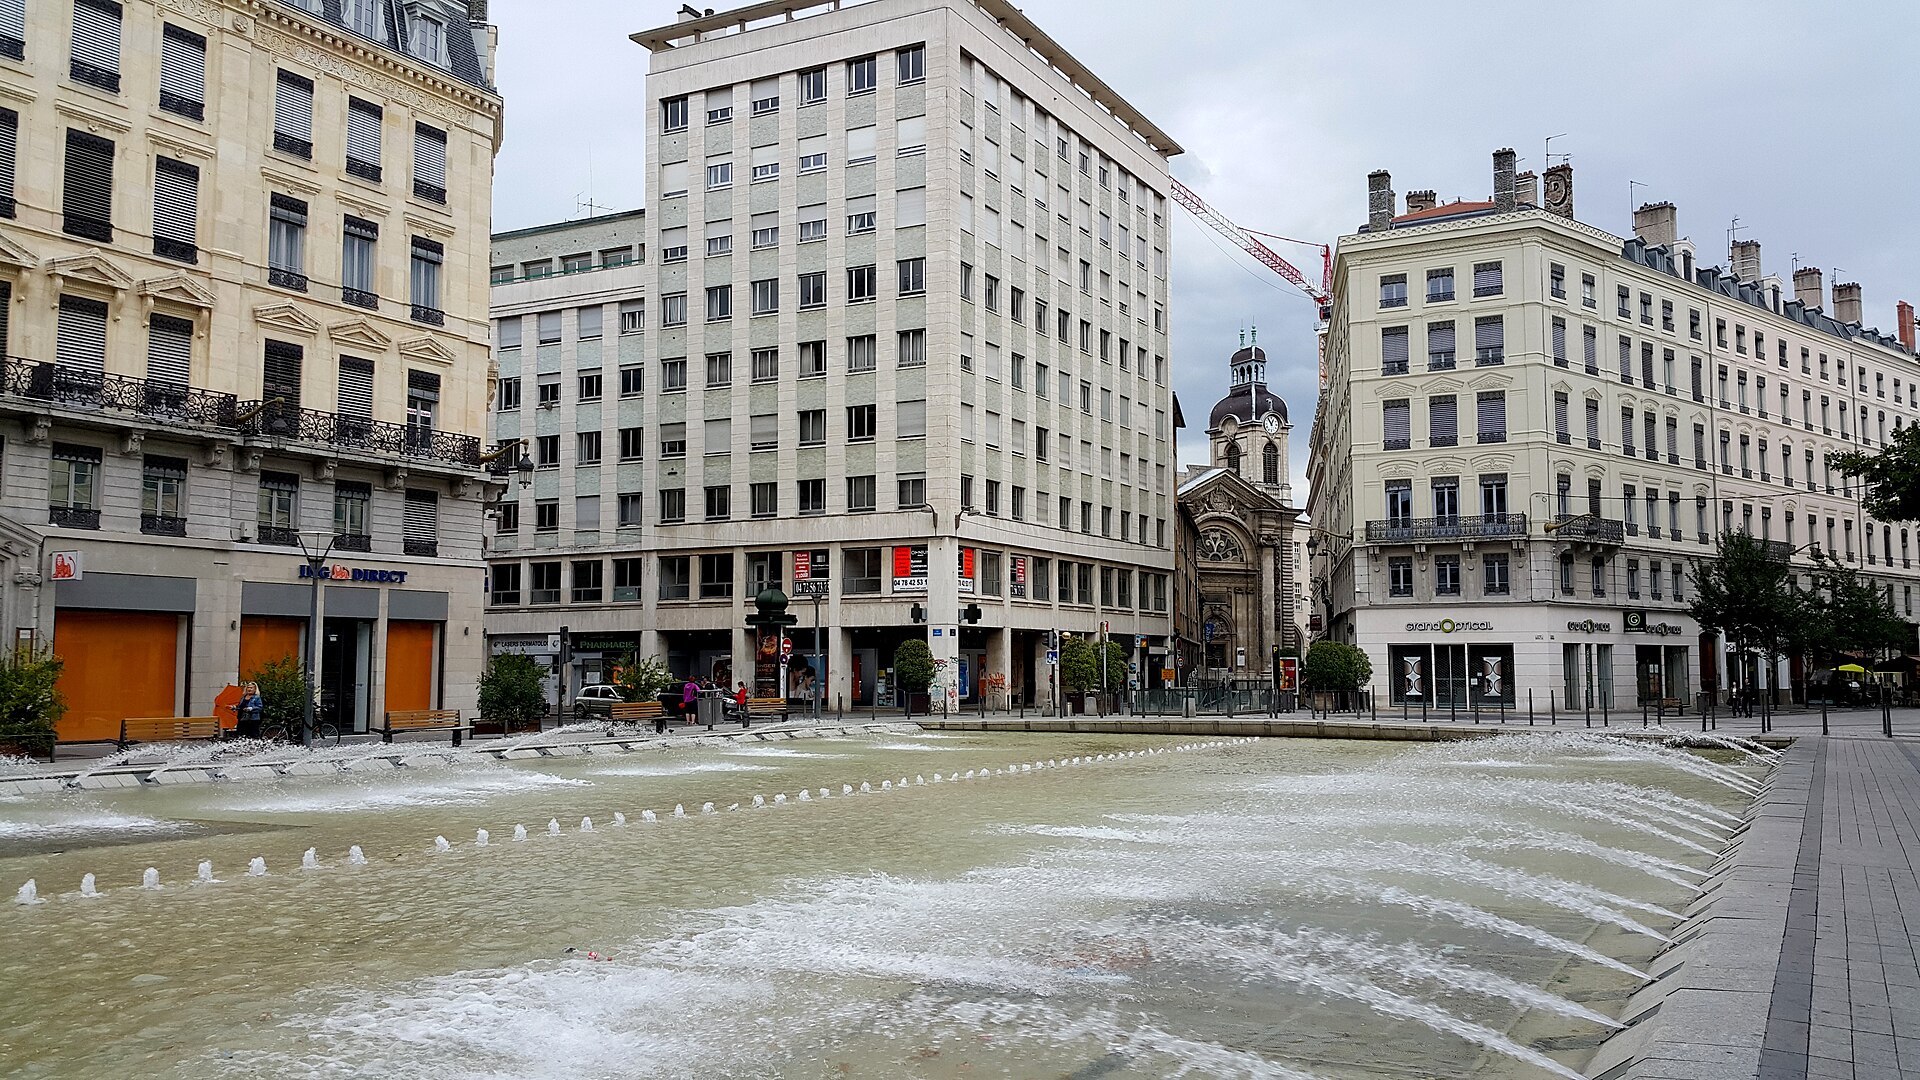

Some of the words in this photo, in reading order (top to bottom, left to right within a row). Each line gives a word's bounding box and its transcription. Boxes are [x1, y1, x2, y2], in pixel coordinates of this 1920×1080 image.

[352, 568, 408, 583] DIRECT
[796, 582, 802, 593] 04
[580, 641, 635, 649] PHARMACIE
